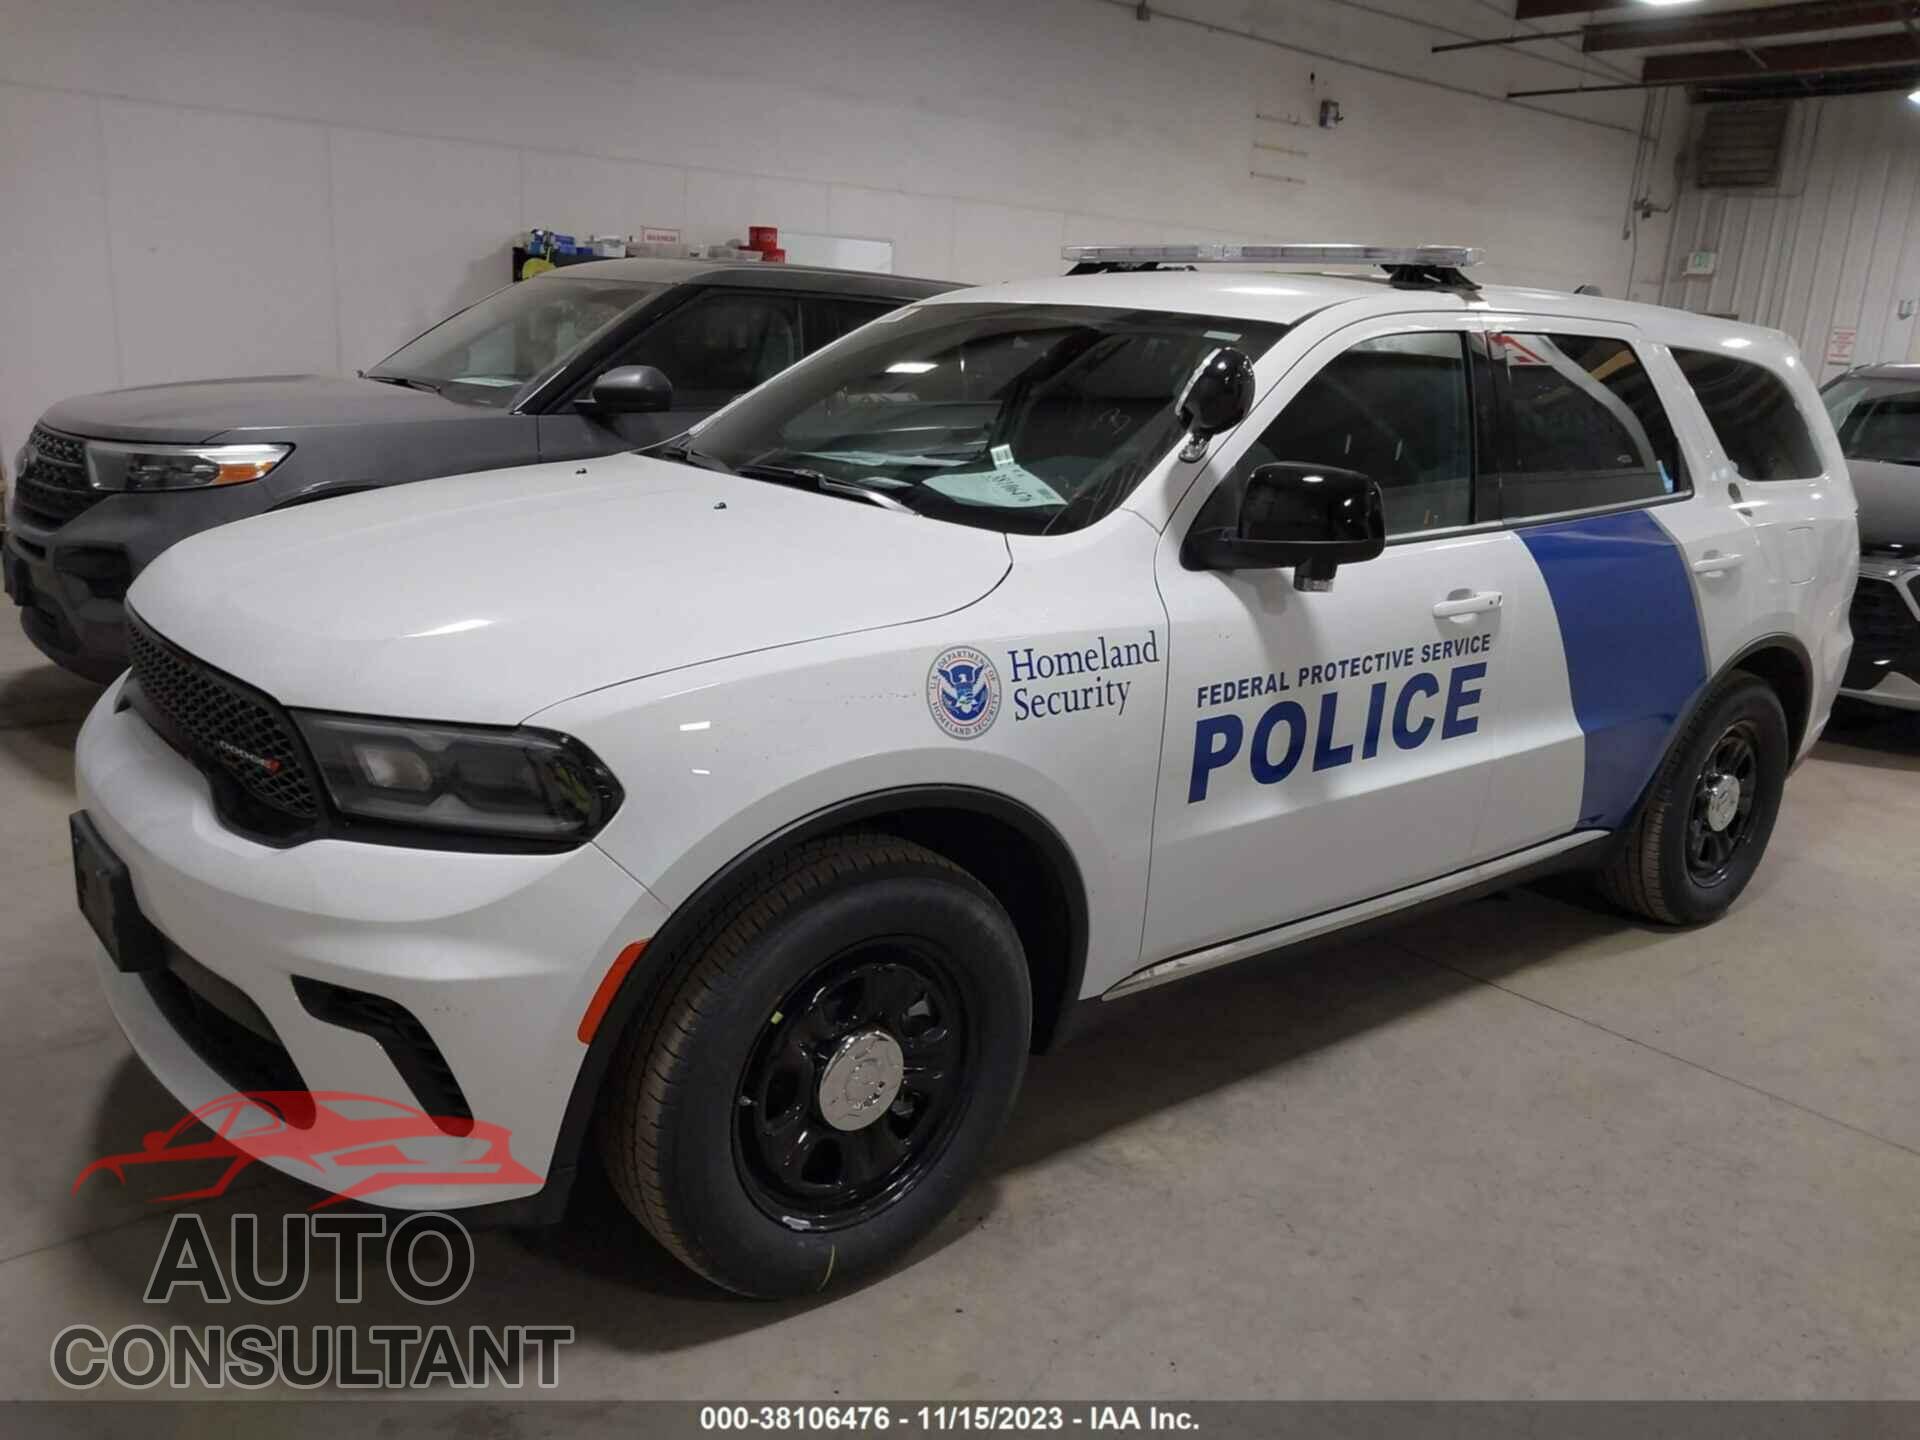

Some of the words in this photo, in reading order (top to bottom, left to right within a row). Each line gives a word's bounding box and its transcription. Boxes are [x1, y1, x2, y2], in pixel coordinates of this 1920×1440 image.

[1008, 630, 1160, 682] Homeland
[1197, 672, 1290, 708] FEDERAL
[1298, 648, 1414, 687] PROTECTIVE
[1421, 634, 1491, 663] SERVICE
[1014, 676, 1131, 721] Security
[1187, 662, 1487, 804] POLICE
